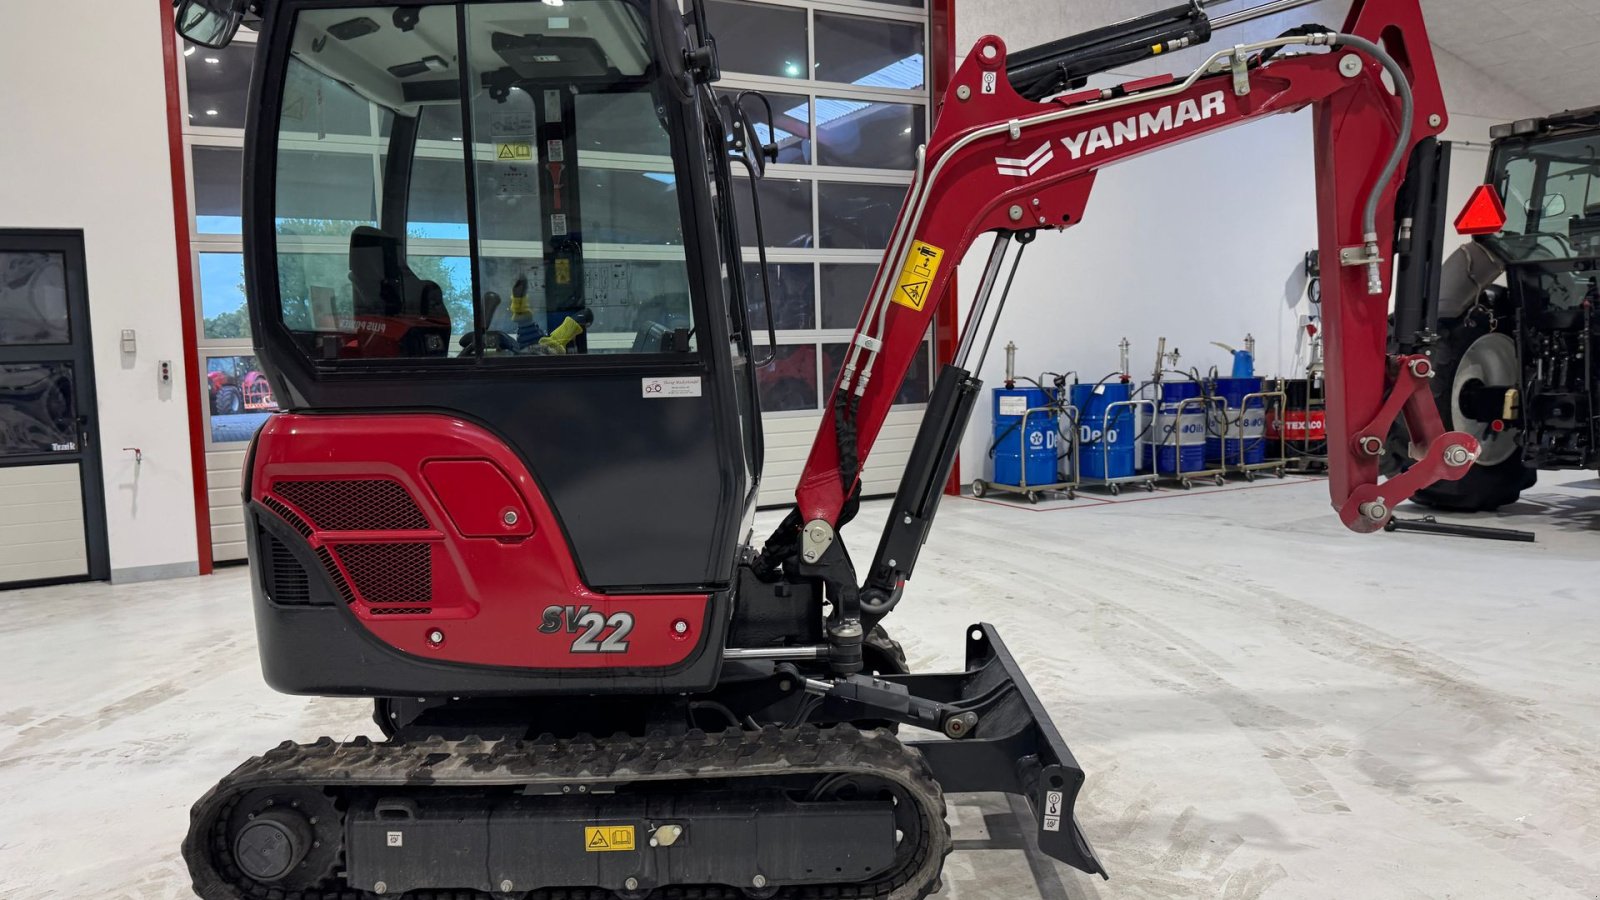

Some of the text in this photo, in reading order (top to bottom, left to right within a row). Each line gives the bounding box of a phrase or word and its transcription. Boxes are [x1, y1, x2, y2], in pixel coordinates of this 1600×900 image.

[1060, 90, 1226, 160] YANMAR
[1080, 425, 1118, 443] Deo
[537, 604, 635, 654] SV22
